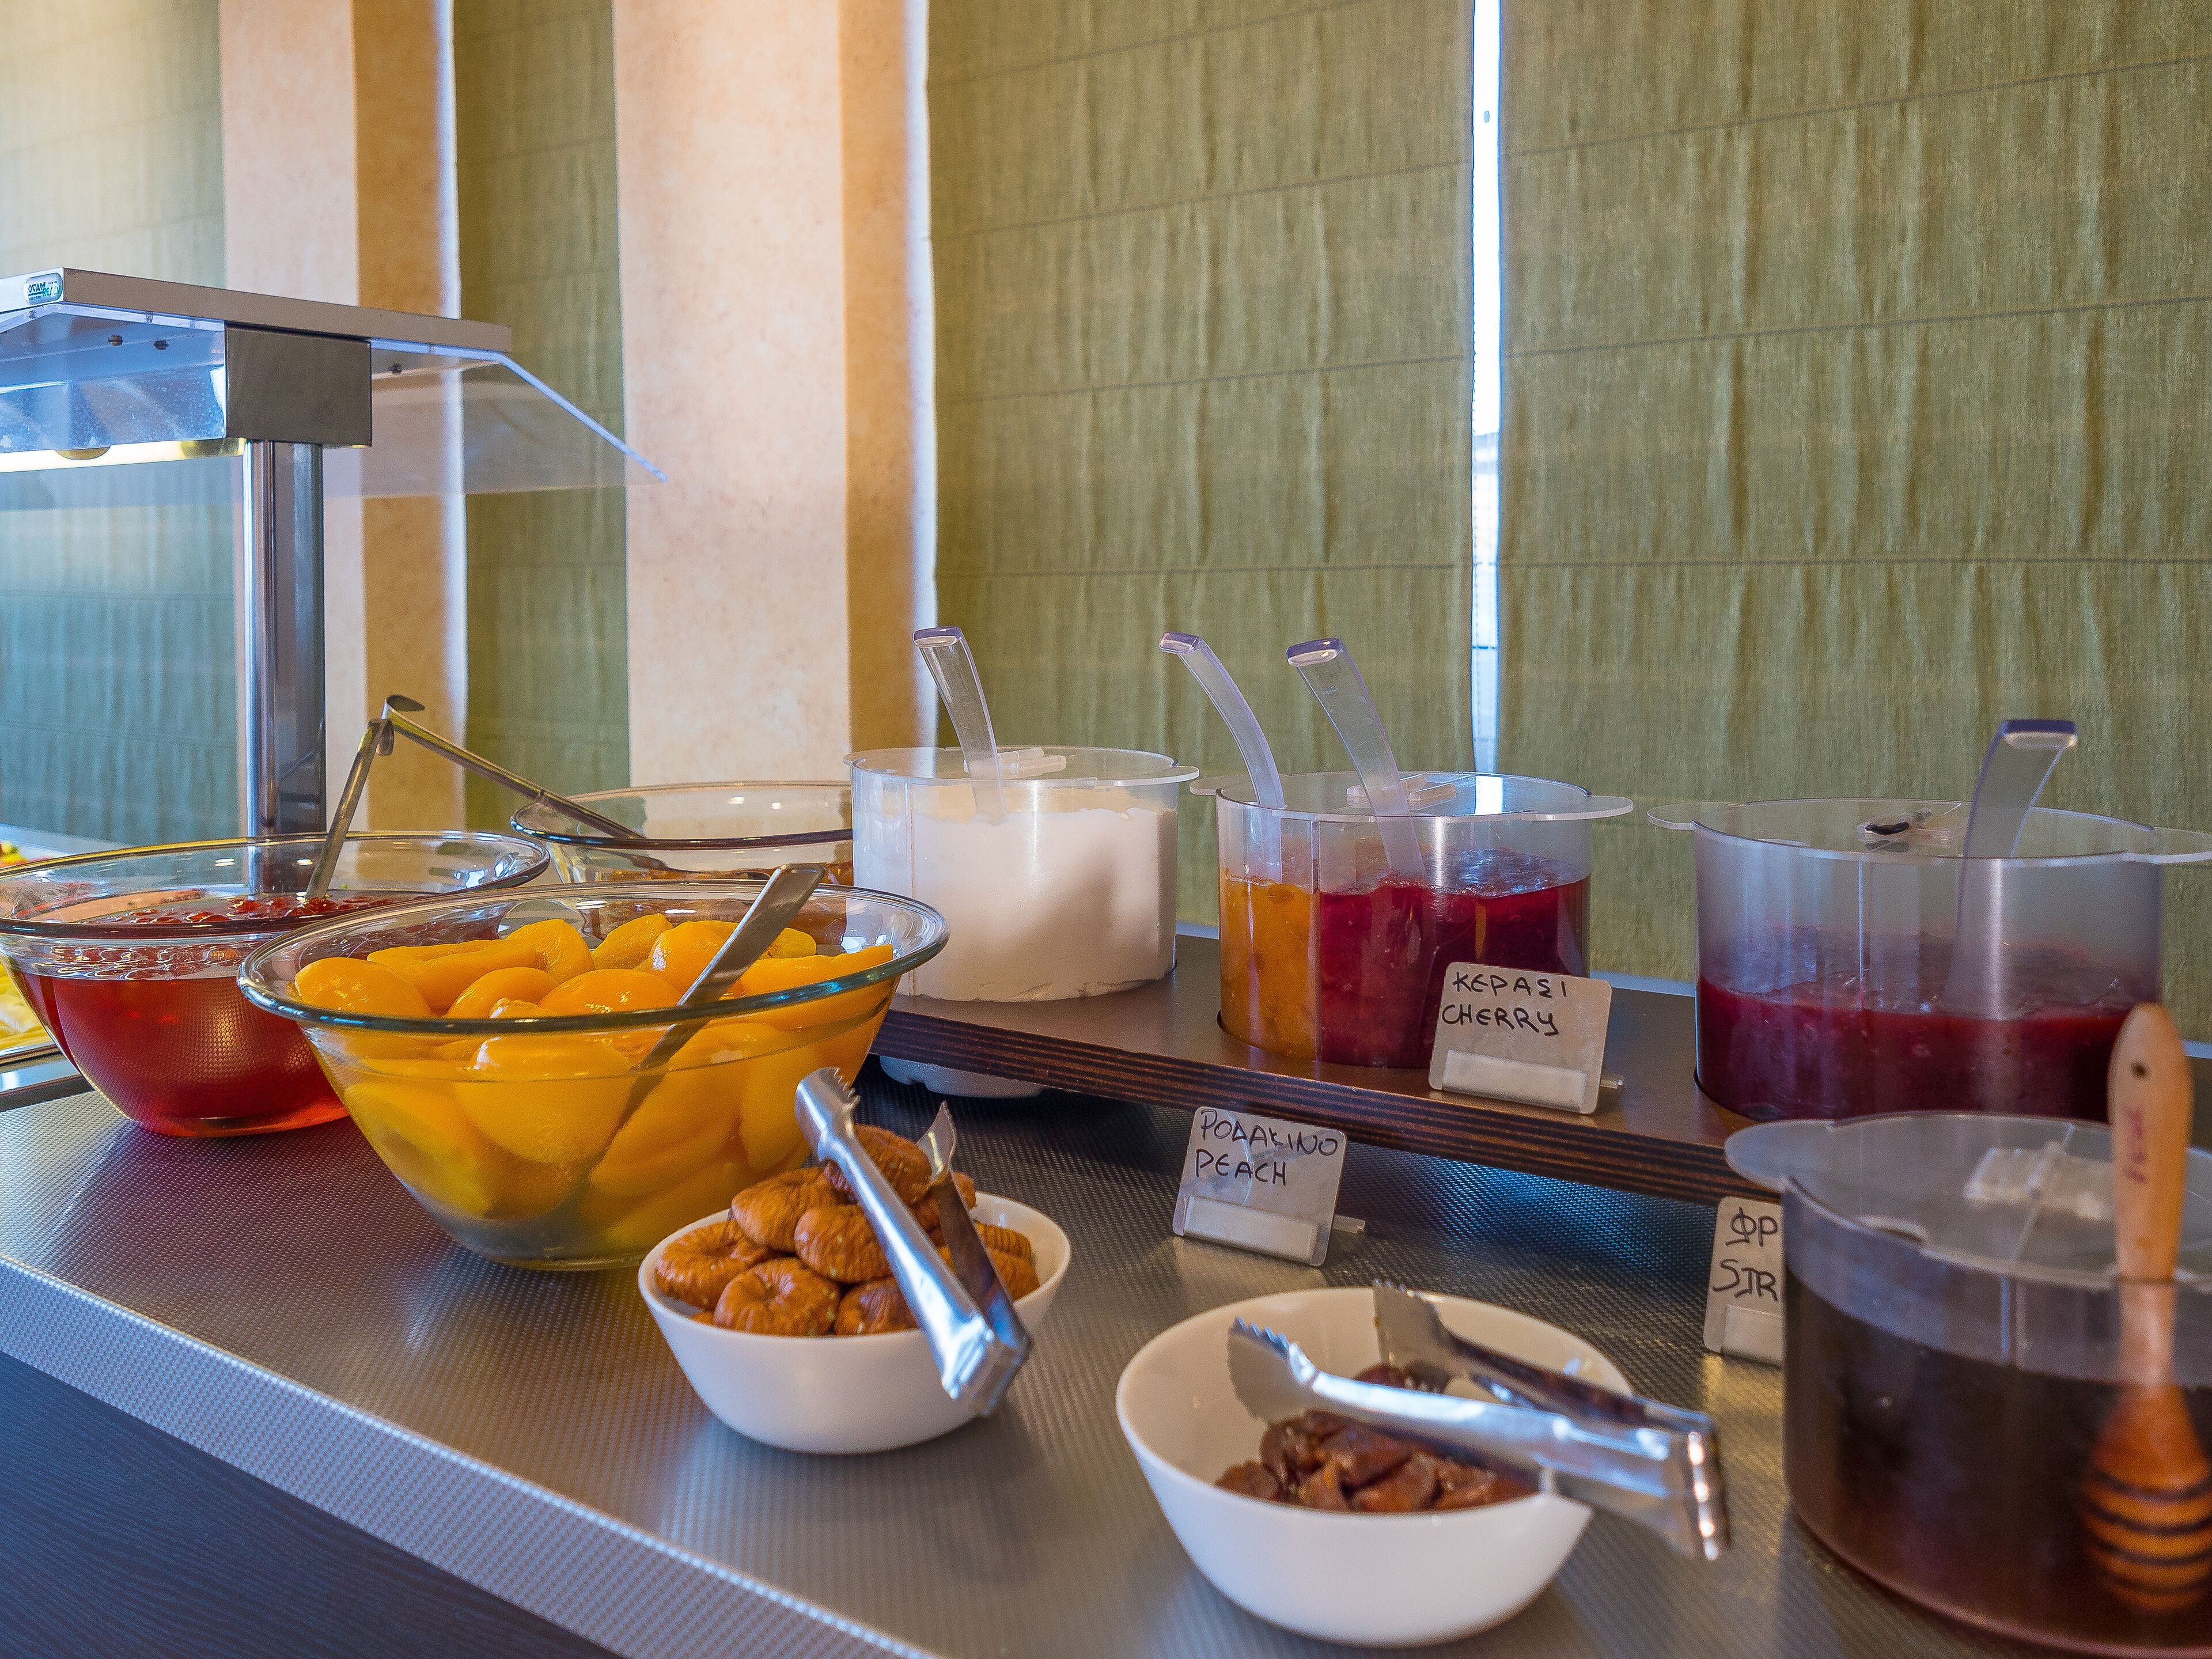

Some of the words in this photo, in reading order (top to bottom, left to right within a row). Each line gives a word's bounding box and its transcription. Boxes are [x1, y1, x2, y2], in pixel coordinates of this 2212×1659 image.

[1452, 971, 1566, 999] ΚΕΡΑΣΙ
[1442, 1003, 1559, 1036] CHERRY
[1196, 1149, 1286, 1187] PEACH
